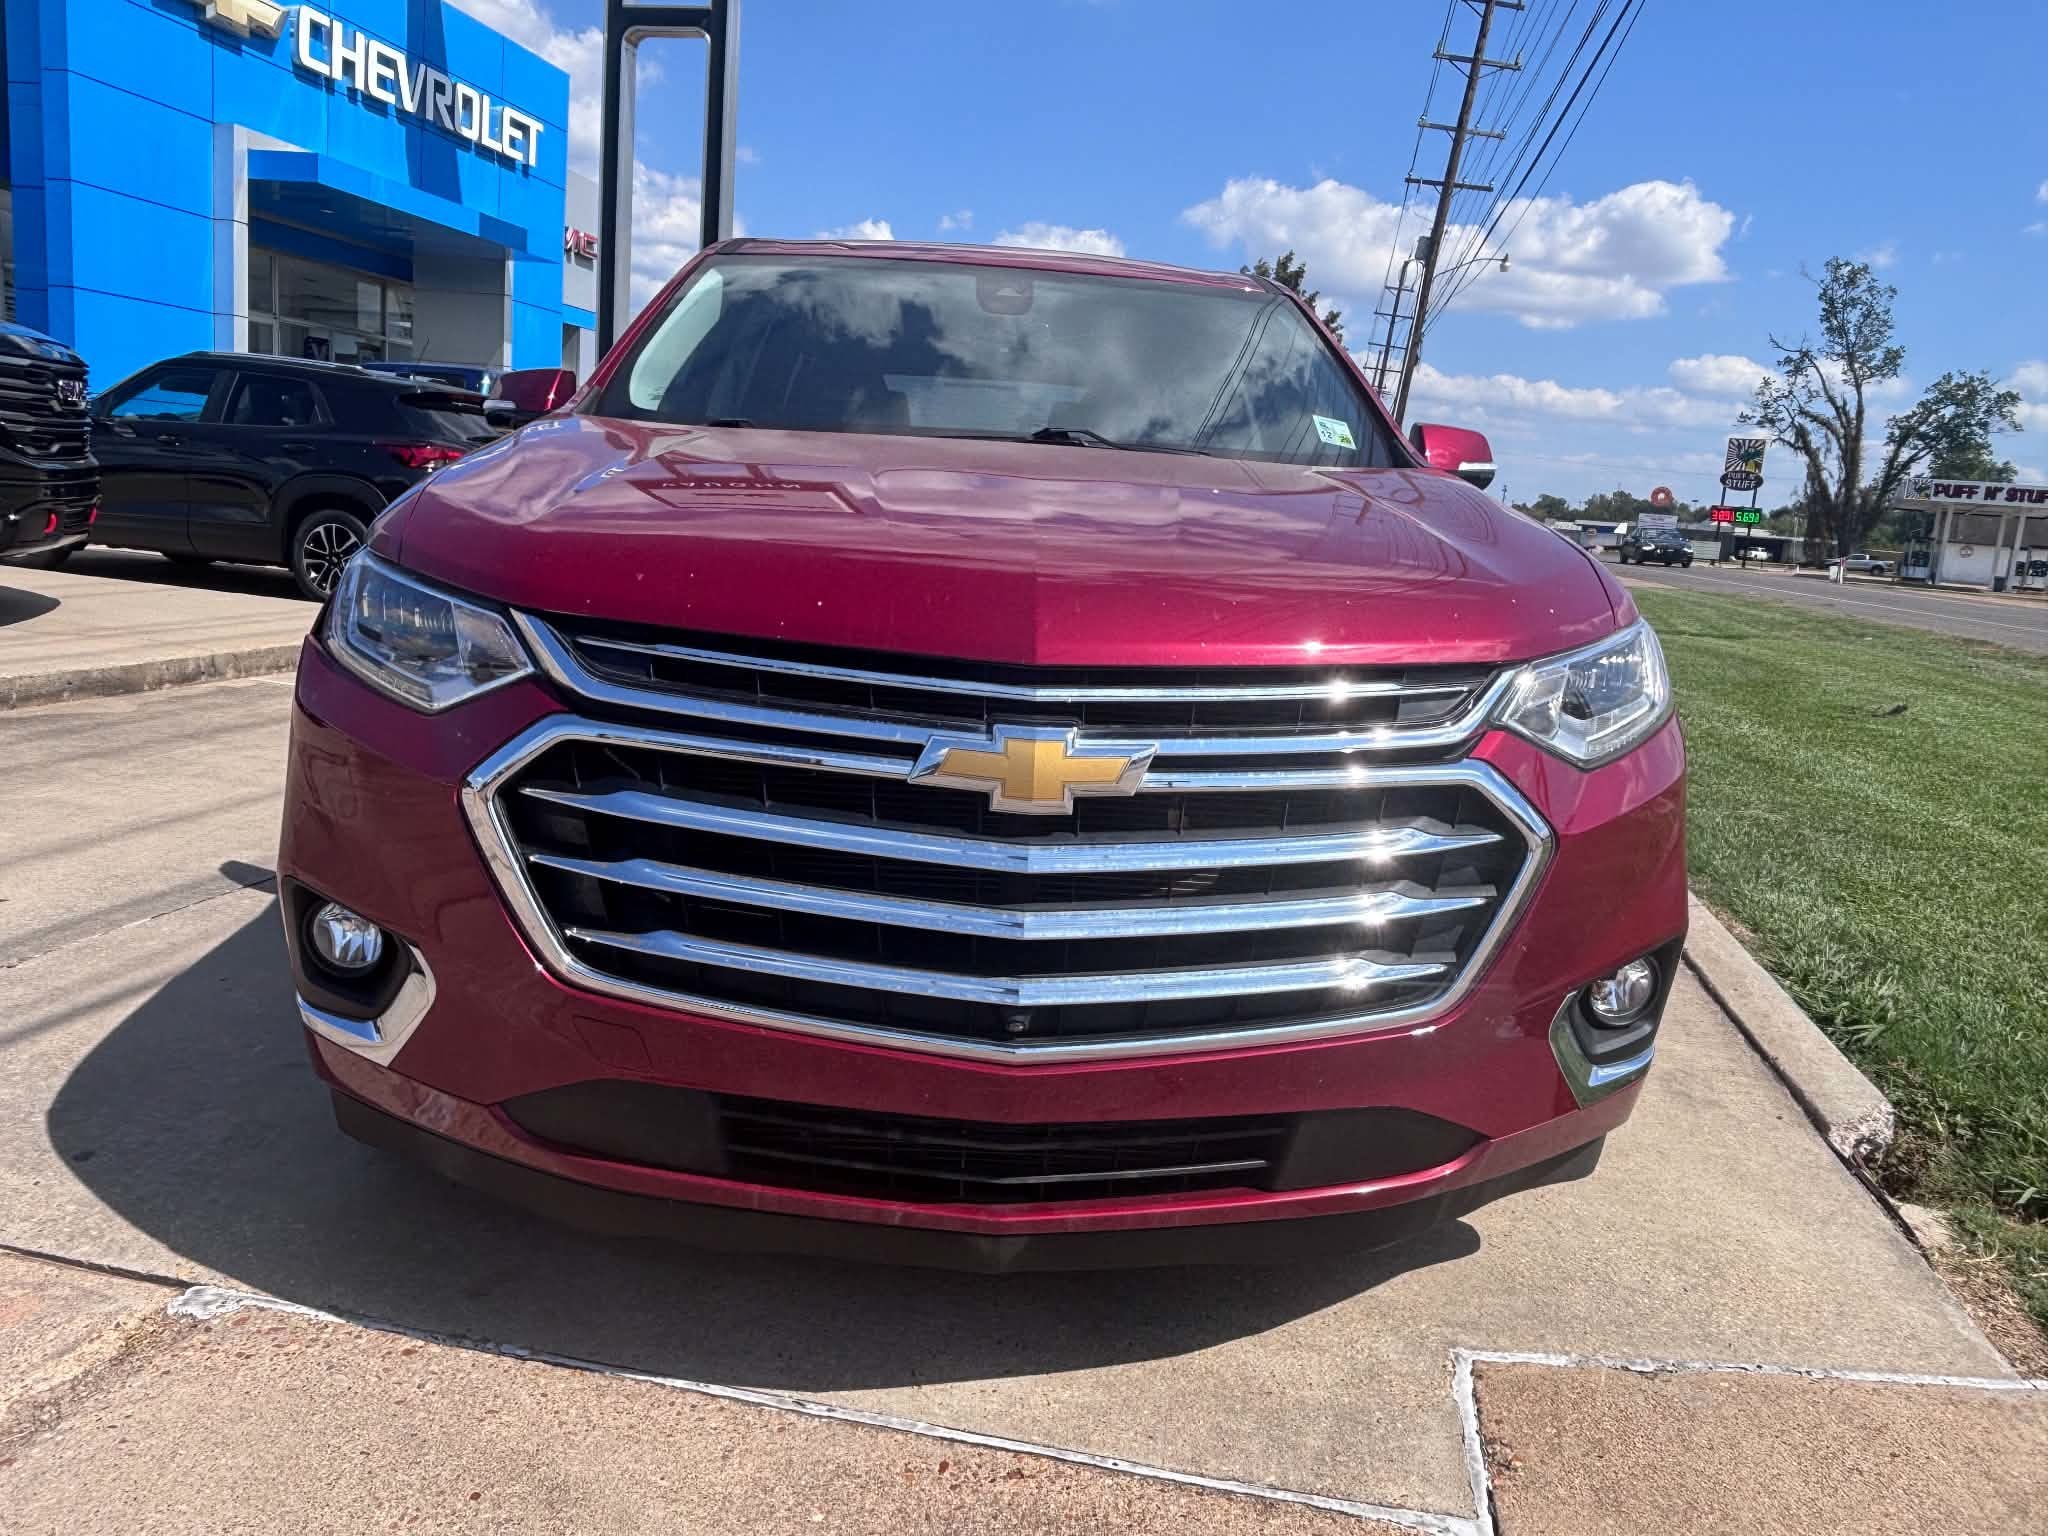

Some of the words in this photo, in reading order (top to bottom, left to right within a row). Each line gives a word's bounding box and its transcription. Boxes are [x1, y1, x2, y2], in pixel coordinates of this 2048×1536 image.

[296, 4, 544, 168] CHEVROLET
[565, 227, 599, 258] MC
[1725, 479, 1757, 488] STUFF
[1932, 483, 1980, 499] PUFF
[2004, 487, 2048, 504] STUF
